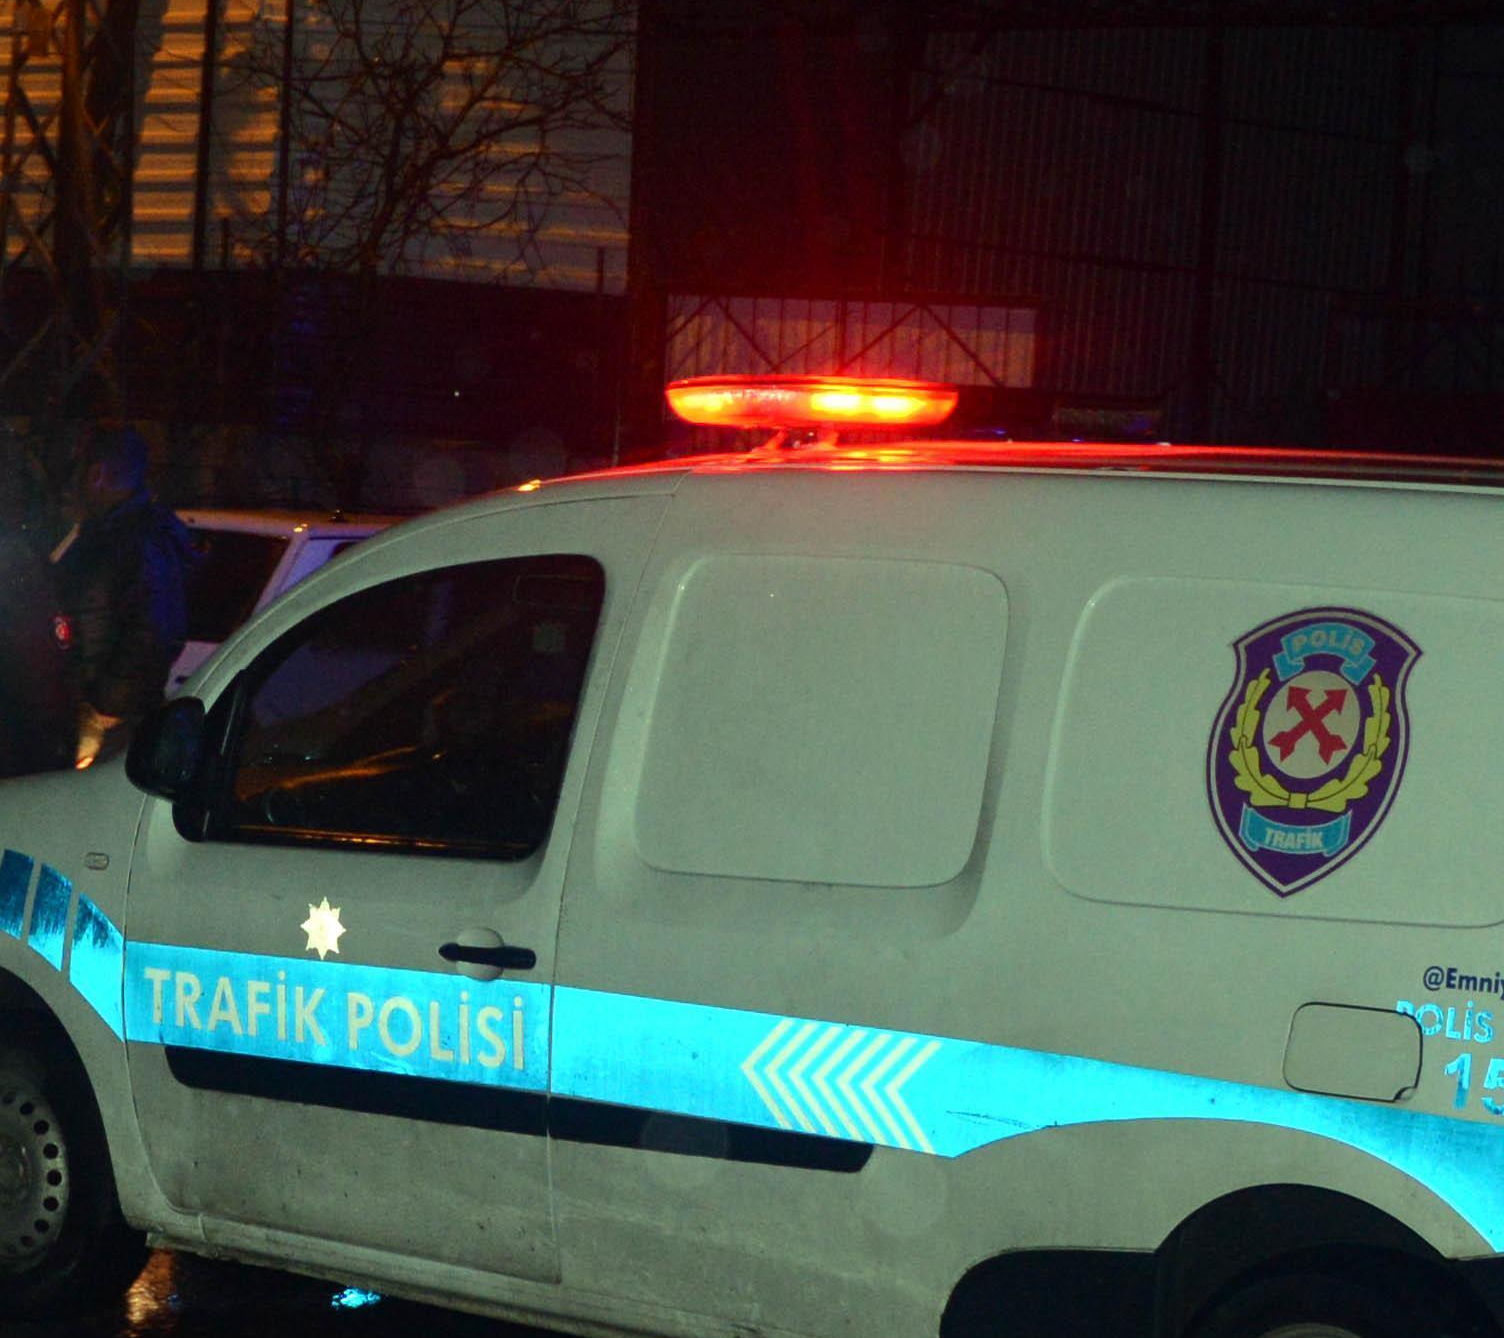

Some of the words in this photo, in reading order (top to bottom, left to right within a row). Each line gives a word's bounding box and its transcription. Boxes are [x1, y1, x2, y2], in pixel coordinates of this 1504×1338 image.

[1264, 826, 1323, 850] TRAFİK
[144, 966, 328, 1047] TRAFİK
[346, 990, 525, 1071] POLİSİ
